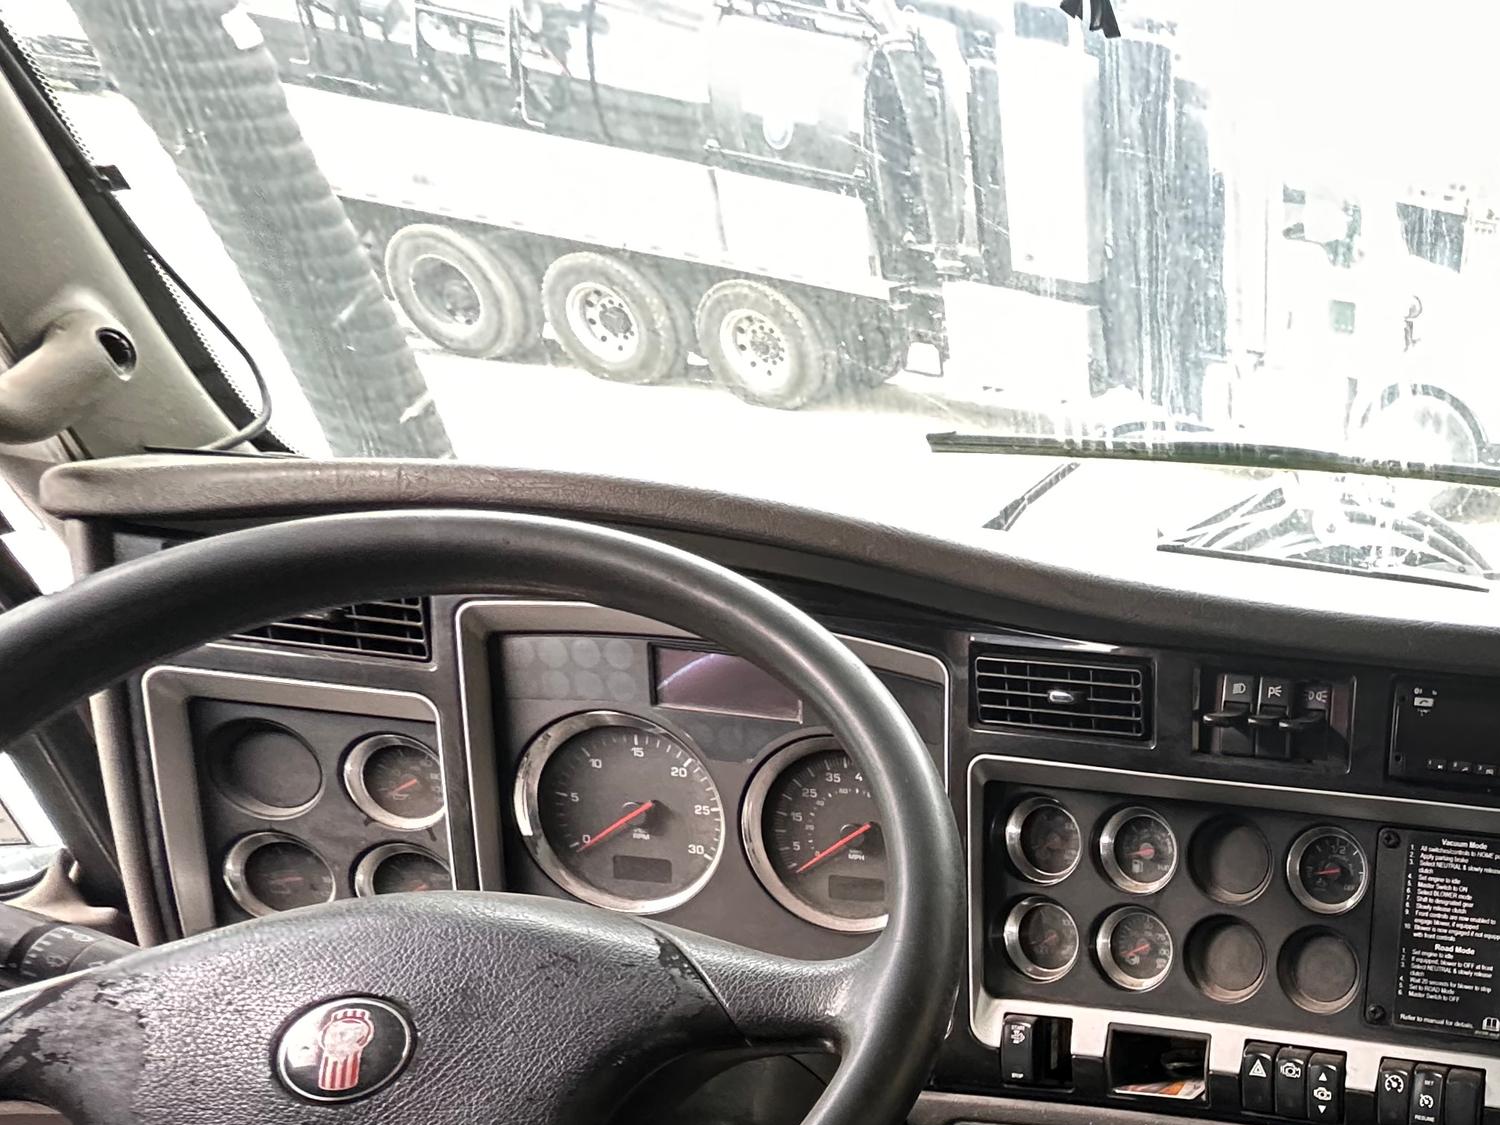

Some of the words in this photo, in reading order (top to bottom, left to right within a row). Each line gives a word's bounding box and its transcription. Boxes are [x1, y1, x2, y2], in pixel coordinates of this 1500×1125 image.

[631, 747, 644, 758] 15
[589, 758, 602, 769] 10
[671, 767, 687, 778] 20
[825, 772, 841, 783] 35
[570, 792, 580, 802] 5
[802, 788, 818, 798] 25
[694, 805, 710, 816] 25
[791, 812, 802, 822] 15
[688, 844, 705, 855] 30
[793, 842, 801, 851] 5
[848, 853, 865, 861] MPH
[1455, 945, 1475, 955] Mode
